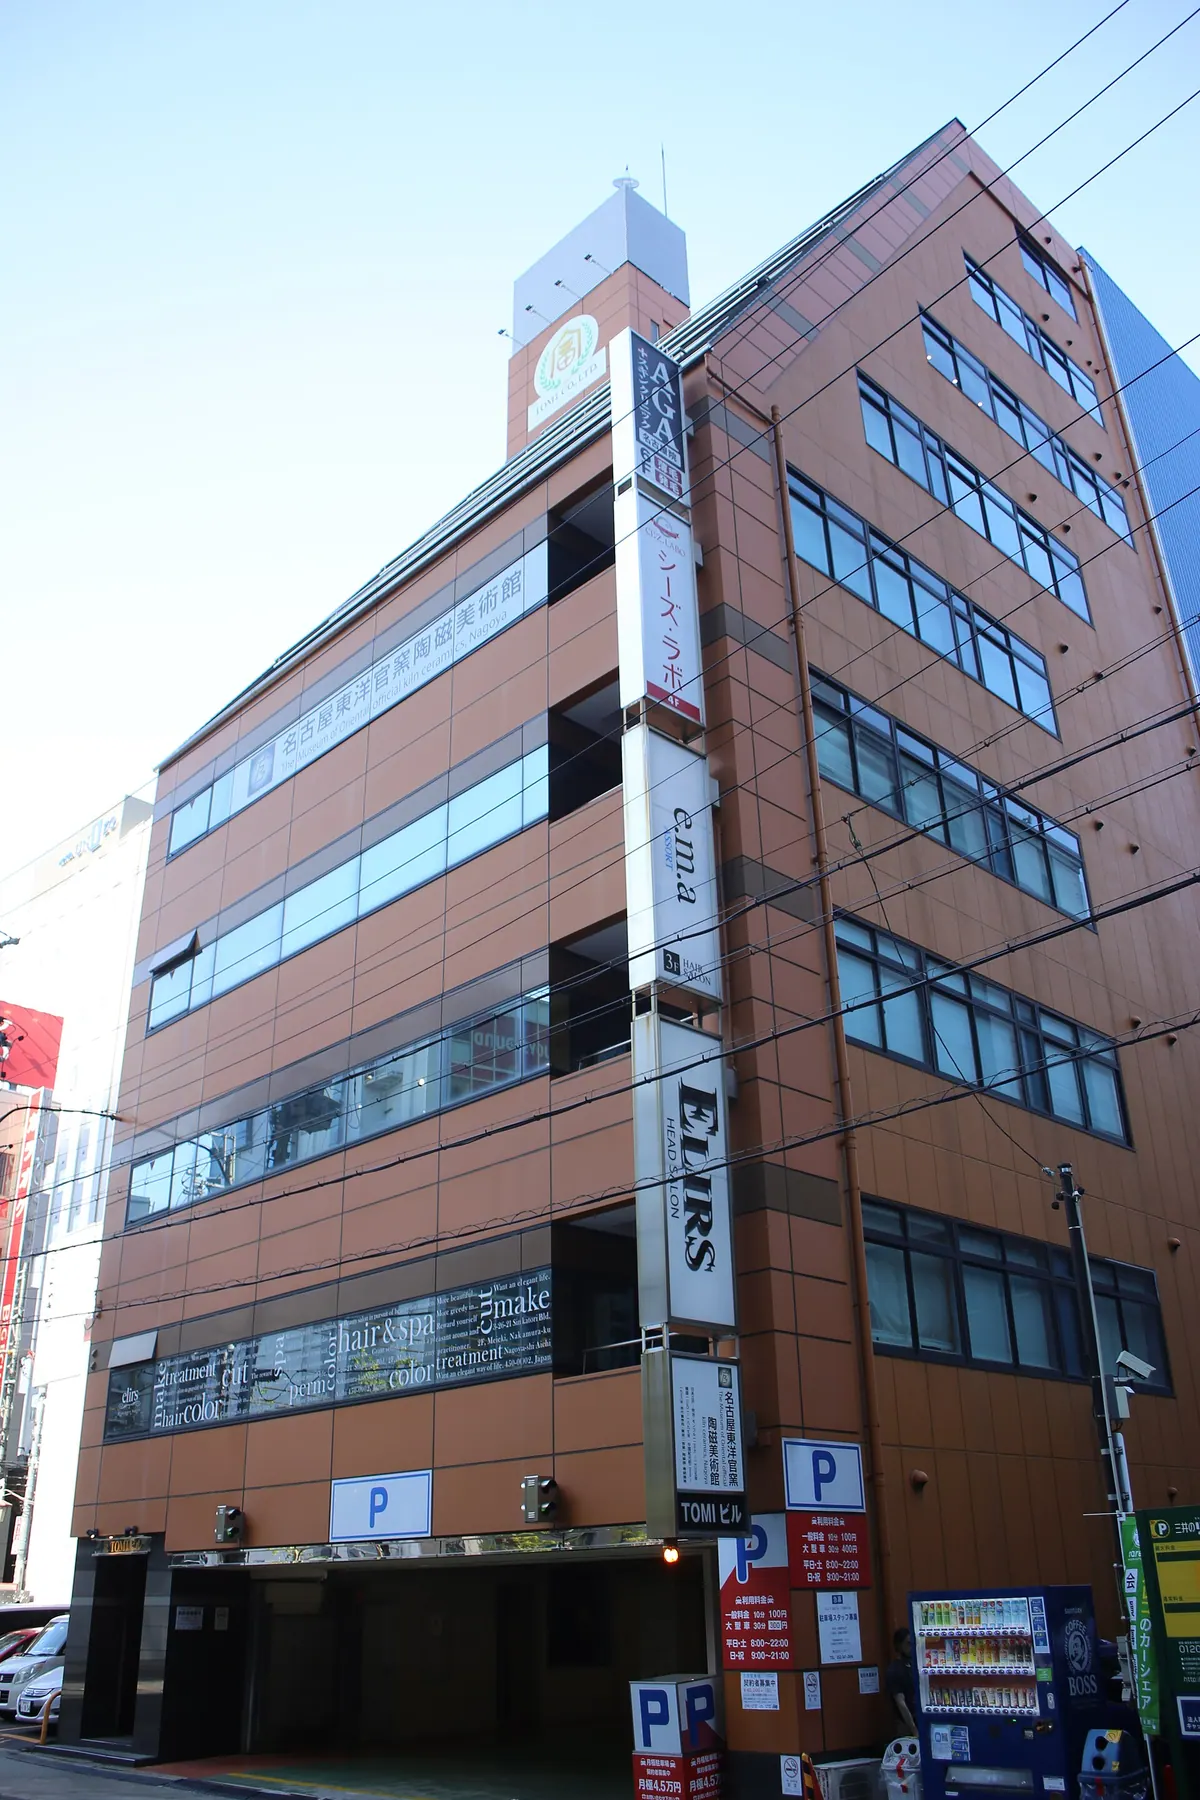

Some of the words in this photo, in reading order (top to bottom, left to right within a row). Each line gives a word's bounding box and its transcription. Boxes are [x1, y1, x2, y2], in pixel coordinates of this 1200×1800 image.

[650, 362, 679, 453] AGA
[658, 550, 683, 691] シーズ・ラボ
[282, 569, 522, 756] 名古屋東洋官窯陶磁美術館
[280, 758, 294, 773] The
[297, 735, 328, 762] Museum
[372, 681, 402, 710] official
[469, 610, 507, 642] Nagoya
[667, 695, 680, 707] 4F
[666, 953, 680, 973] 3F
[666, 1117, 677, 1162] HEAD
[478, 1286, 494, 1335] cut
[494, 1287, 550, 1320] make
[165, 1361, 217, 1386] treatment
[222, 1361, 249, 1387] cut
[324, 1331, 337, 1391] color
[389, 1356, 435, 1389] color
[436, 1344, 503, 1371] treatment
[154, 1362, 168, 1428] make
[289, 1378, 326, 1405] perm
[708, 1416, 720, 1486] 陶磁美術館
[724, 1391, 739, 1487] 名古屋東洋官窯
[812, 1450, 836, 1502] P
[370, 1487, 388, 1528] P
[681, 1502, 716, 1523] TOMI
[719, 1503, 742, 1524] ビル
[841, 1533, 857, 1542] 100円
[1158, 1523, 1167, 1535] P
[736, 1524, 768, 1584] P
[725, 1610, 750, 1619] 一般料金
[769, 1609, 787, 1618] 100円
[1065, 1619, 1087, 1635] COFFEE
[1068, 1674, 1098, 1696] BOSS
[639, 1689, 670, 1748] P
[686, 1684, 715, 1748] P
[638, 1778, 681, 1794] 月極4.5万円
